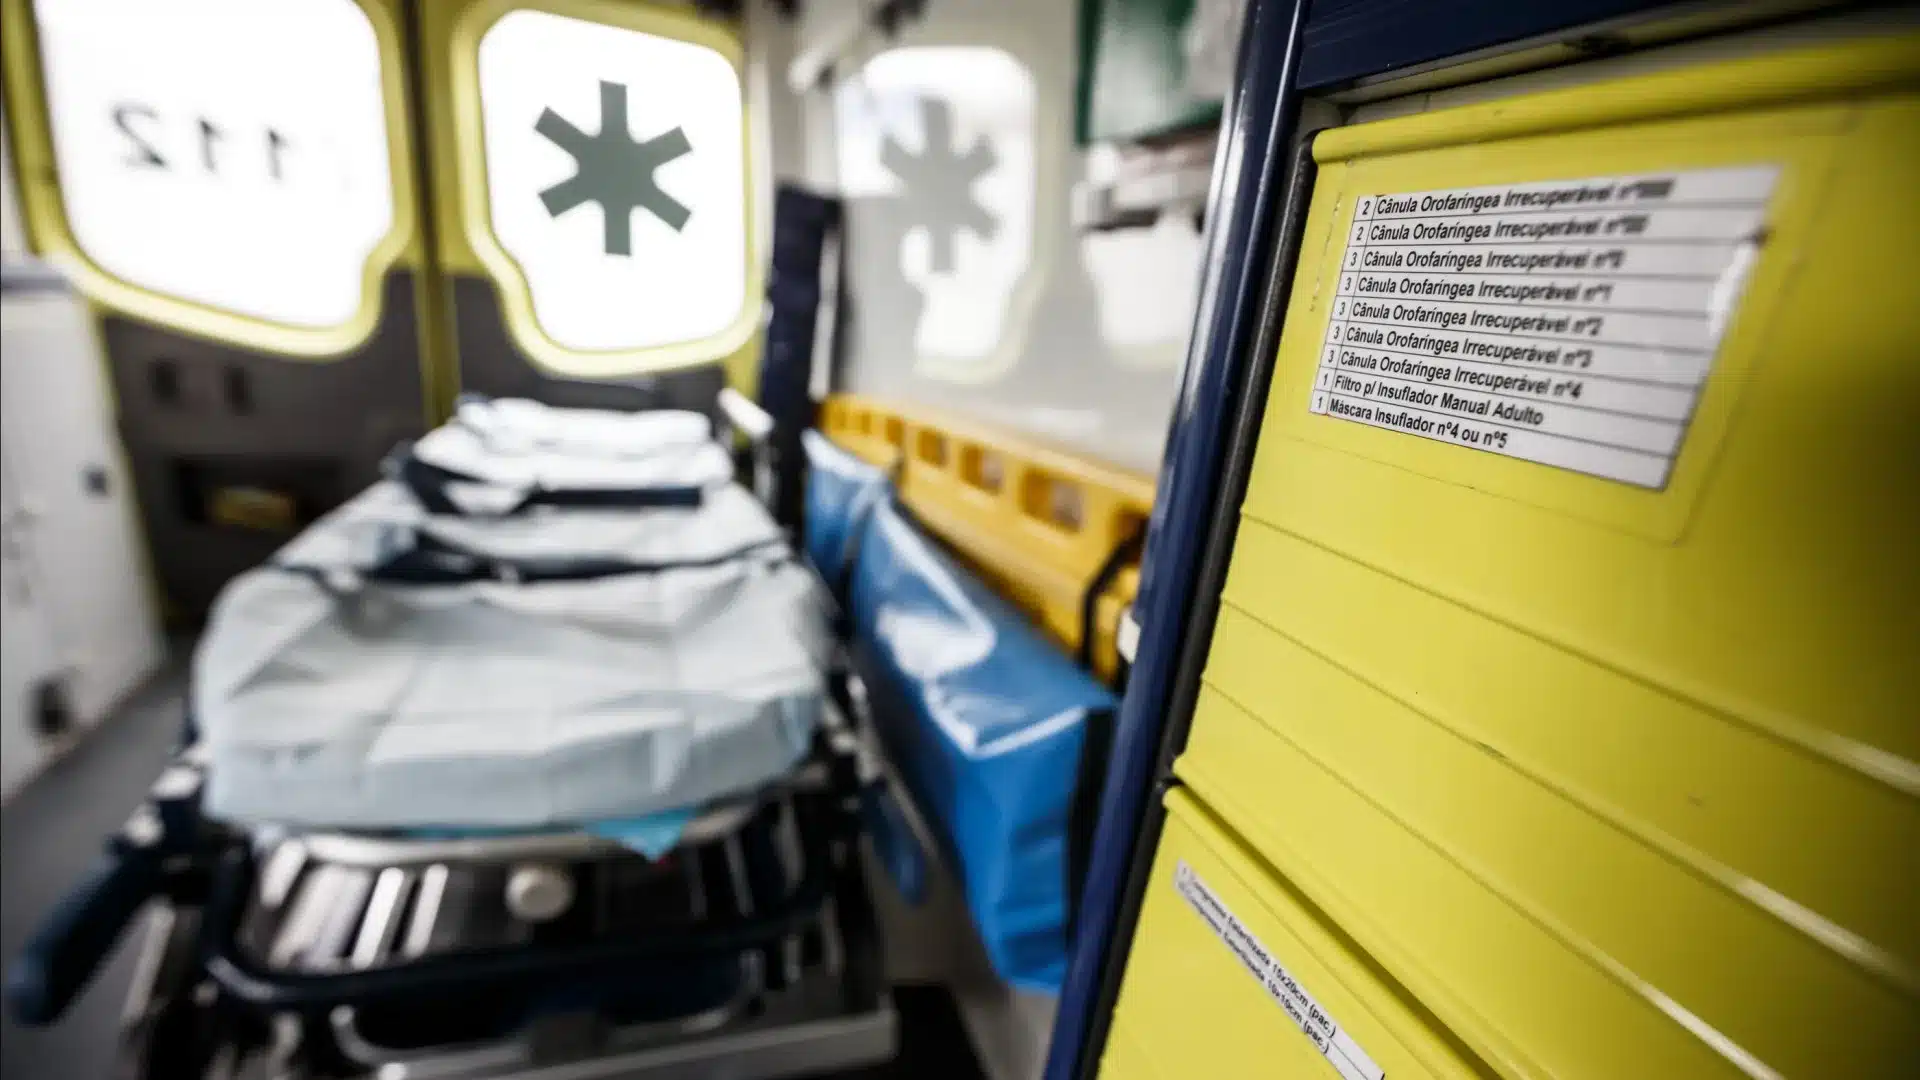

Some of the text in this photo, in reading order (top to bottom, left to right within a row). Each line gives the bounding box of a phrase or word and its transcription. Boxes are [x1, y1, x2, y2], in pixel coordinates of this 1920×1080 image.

[1362, 201, 1370, 215] 2
[1377, 197, 1418, 214] Cânula
[1420, 192, 1501, 213] Orofaríngea
[1356, 226, 1364, 241] 2
[1370, 224, 1410, 241] Cânula
[1413, 221, 1491, 242] Orofaríngea
[1494, 217, 1601, 241] Irrecuperável
[1350, 252, 1358, 267] 3
[1364, 250, 1403, 267] Cânula
[1406, 250, 1482, 271] Orofaríngea
[1486, 249, 1590, 272] Irrecuperável
[1344, 277, 1352, 291] 3
[1358, 277, 1397, 293] Cânula
[1399, 278, 1475, 300] Orofaríngea
[1478, 280, 1581, 302] Irrecuperável
[1339, 302, 1346, 315] 3
[1352, 302, 1390, 319] Cânula
[1393, 304, 1467, 328] Orofaríngea
[1470, 310, 1570, 333] Irrecuperável
[1333, 326, 1340, 339] 3
[1346, 327, 1383, 345] Cânula
[1386, 331, 1459, 355] Orofaríngea
[1462, 338, 1562, 364] Irrecuperável
[1328, 350, 1334, 363] 3
[1340, 351, 1377, 369] Cânula
[1380, 356, 1451, 382] Orofaríngea
[1454, 366, 1551, 394] Irrecuperável
[1323, 373, 1544, 426] 1 Filtro p/ Insuflador Manual Adulto
[1318, 396, 1508, 449] 1 Máscara Insuflador nº4 ou nº5
[1303, 1020, 1330, 1054] (pac.)
[1309, 1003, 1337, 1039] (pac.)
